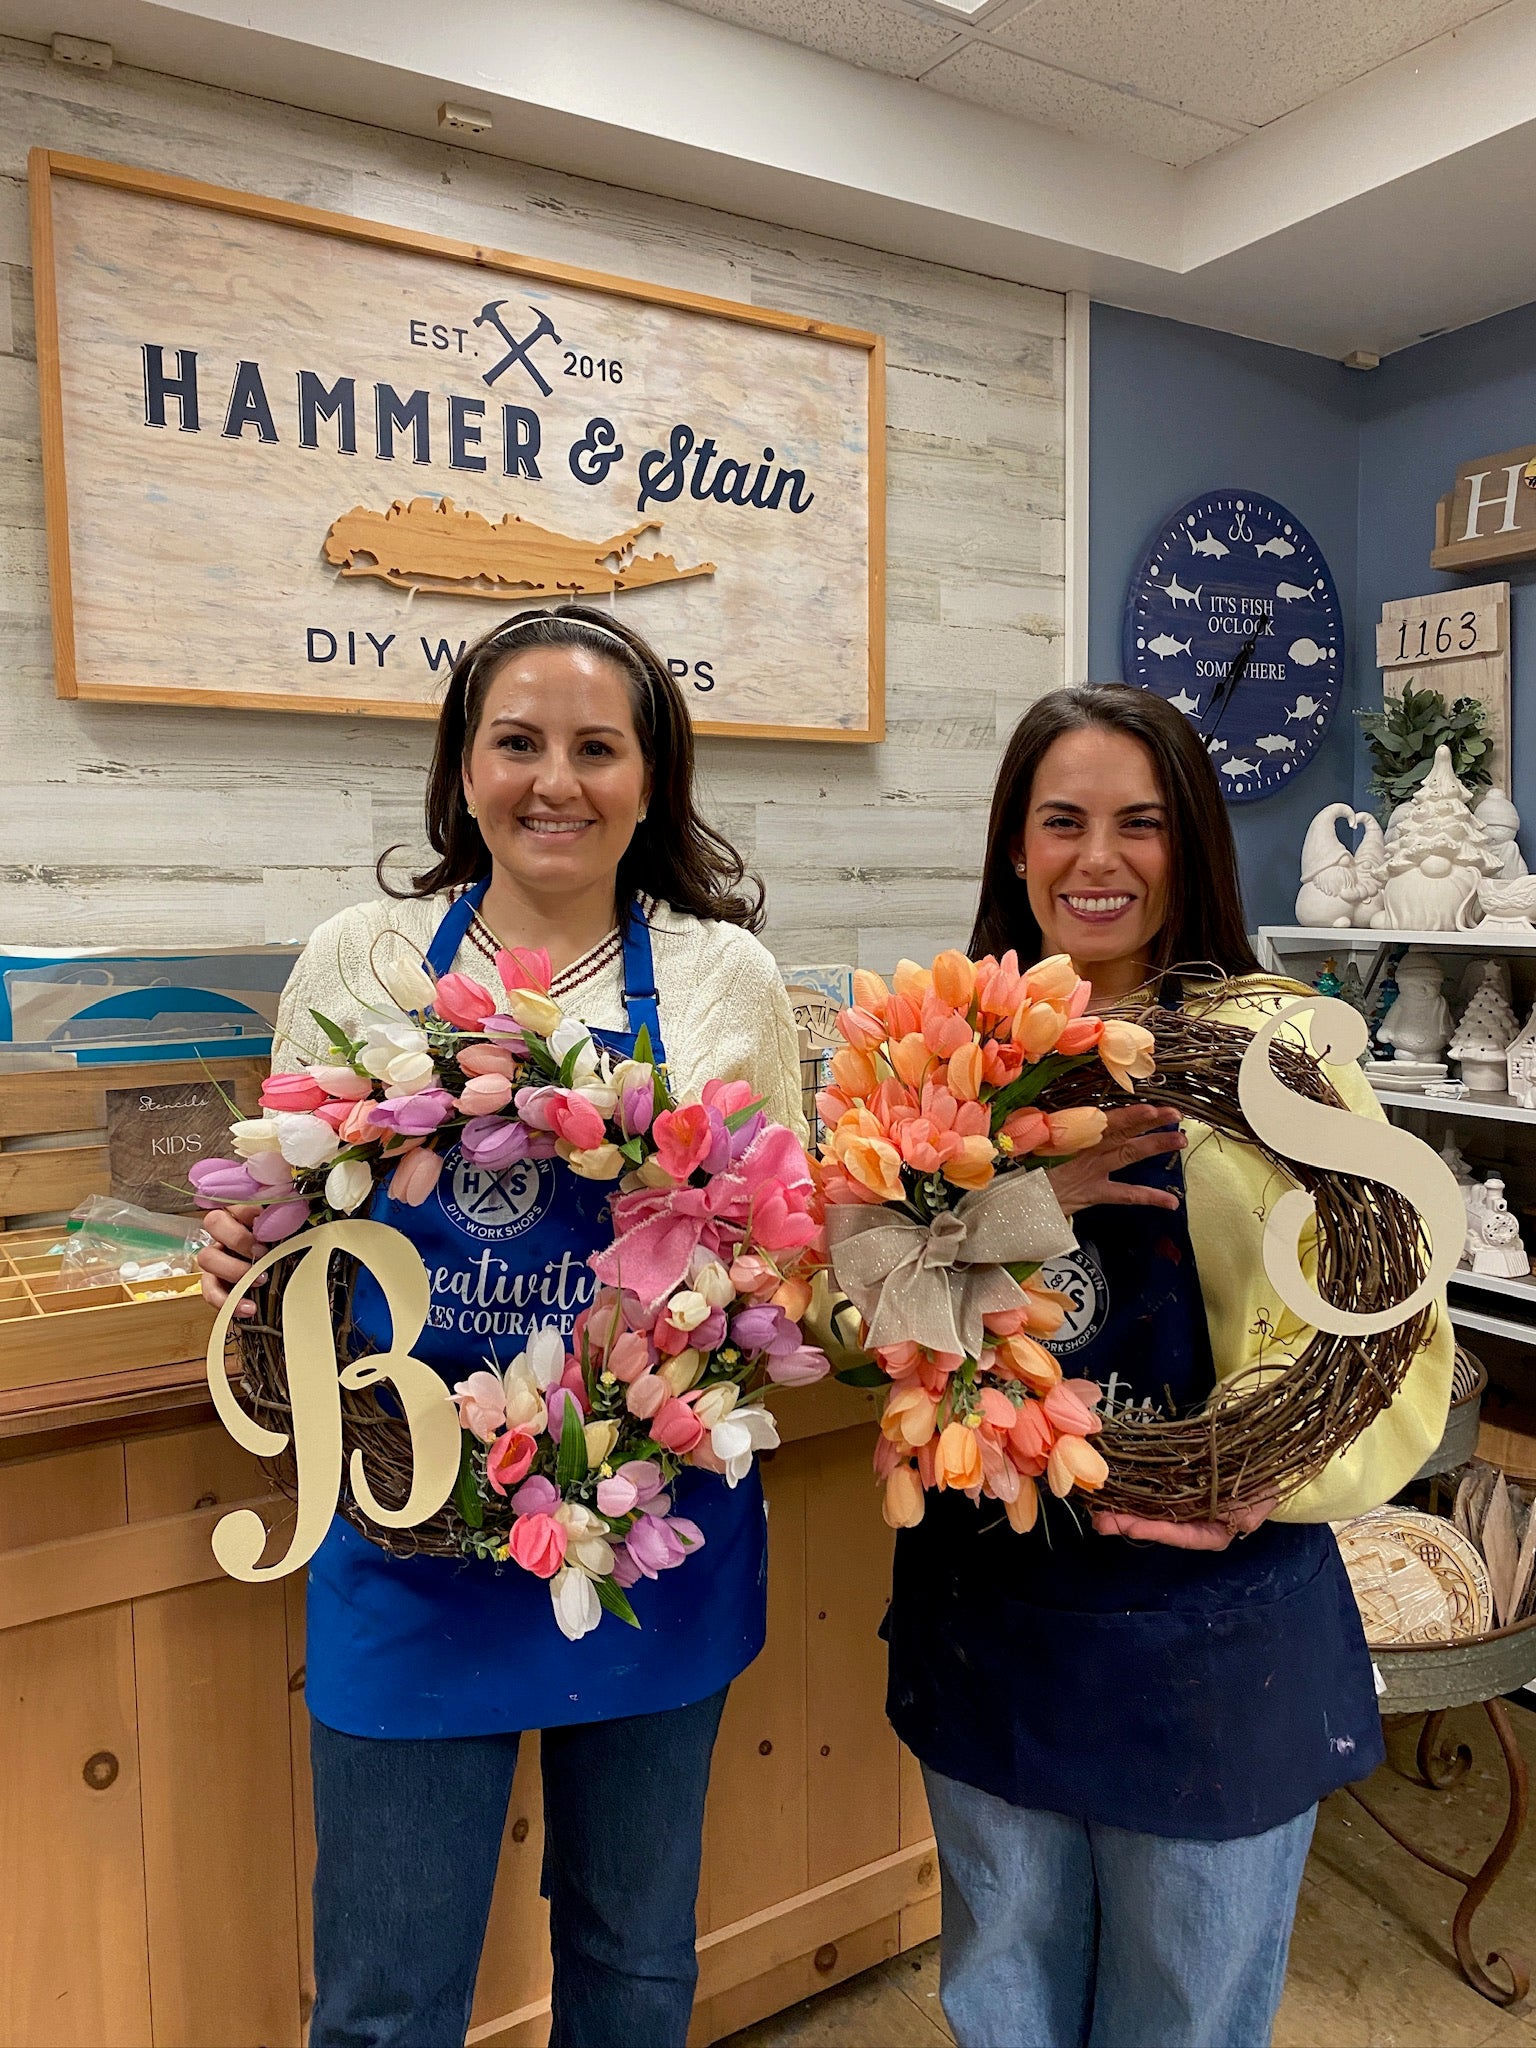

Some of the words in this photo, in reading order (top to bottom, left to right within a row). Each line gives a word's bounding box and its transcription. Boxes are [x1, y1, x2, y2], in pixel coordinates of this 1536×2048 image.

[410, 320, 478, 357] EST.
[563, 351, 624, 384] 2016
[141, 343, 544, 482] HAMMER
[569, 416, 624, 485] &
[637, 424, 814, 513] Stain
[1211, 596, 1237, 614] IT'S
[1241, 598, 1273, 617] FISH
[1208, 616, 1275, 636] O'CLOCK
[1395, 611, 1478, 661] 1163
[306, 627, 396, 668] DIY
[138, 1095, 209, 1111] Stencils
[151, 1134, 203, 1156] KIDS
[462, 1172, 480, 1194] H
[511, 1173, 528, 1196] S
[1238, 996, 1467, 1336] S
[446, 1203, 466, 1222] DIY
[466, 1204, 543, 1239] WORKSHOPS
[422, 1247, 602, 1311] reativit
[1075, 1254, 1105, 1291] STAIN
[425, 1304, 455, 1330] KES
[458, 1310, 575, 1336] COURAGE
[1038, 1323, 1098, 1353] ORKSHOPS
[207, 1219, 462, 1582] B
